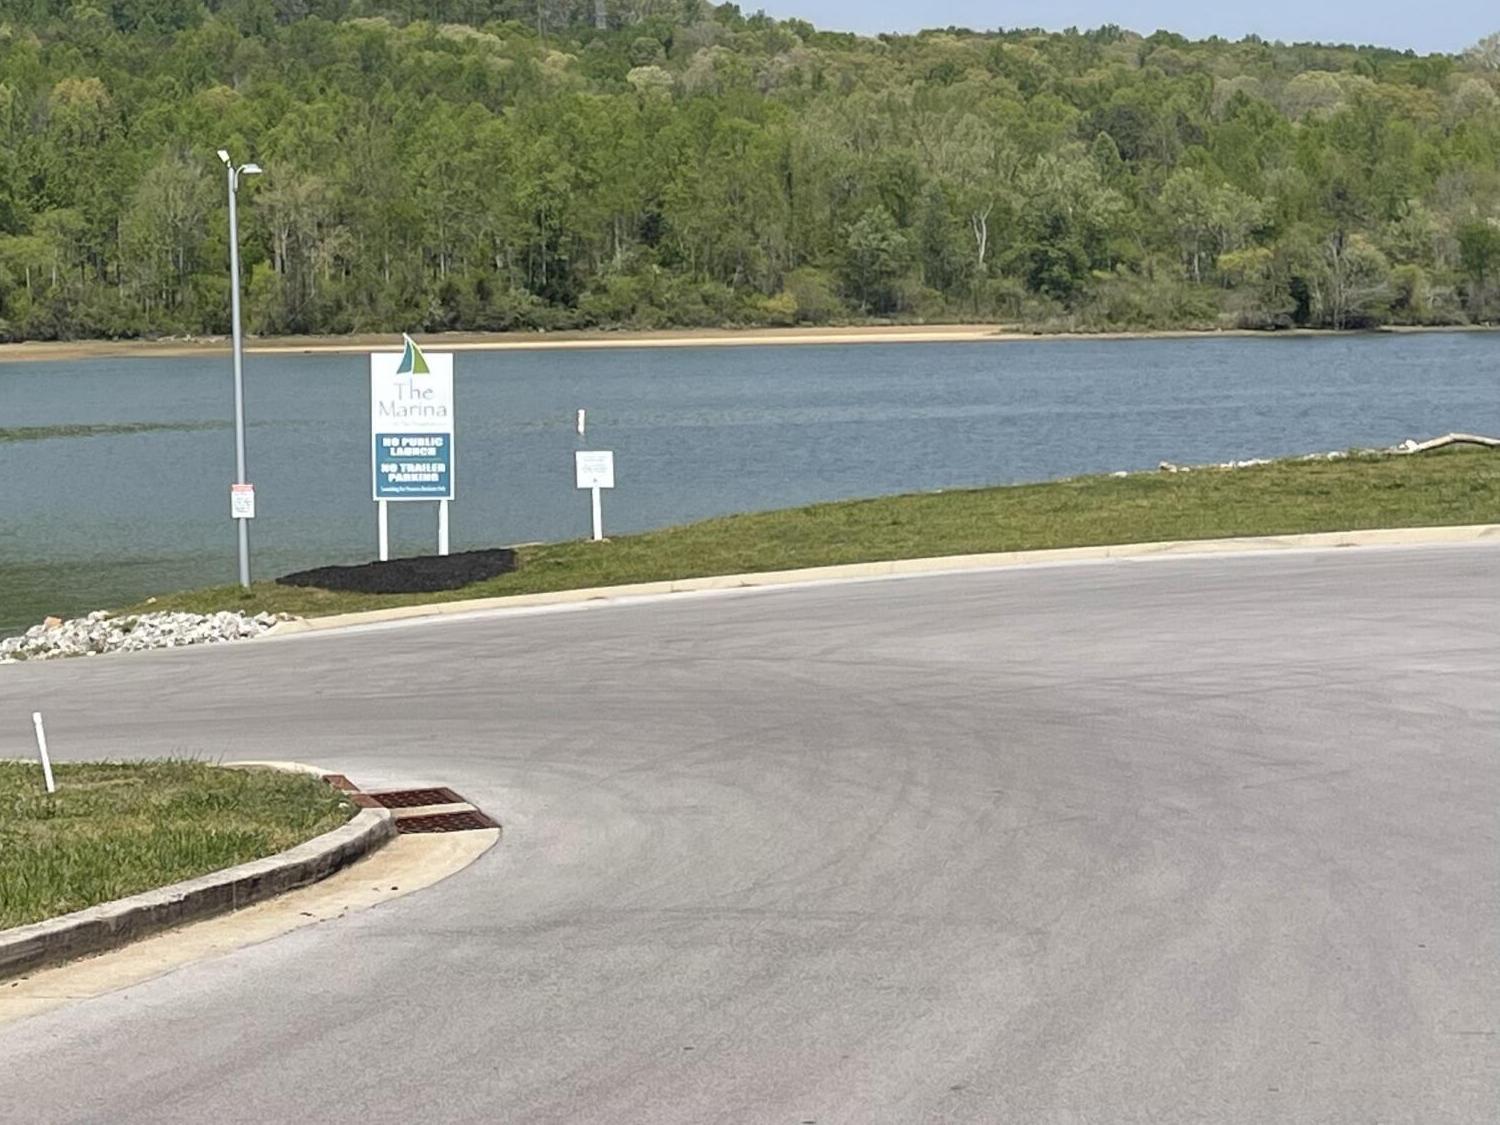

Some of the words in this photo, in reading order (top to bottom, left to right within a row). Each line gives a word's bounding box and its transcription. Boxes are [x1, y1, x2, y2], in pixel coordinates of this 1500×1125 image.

[393, 377, 435, 400] The
[379, 400, 447, 417] Marina
[382, 437, 400, 447] NO
[401, 437, 444, 447] PUBLIC
[381, 463, 398, 473] NO
[399, 463, 446, 473] TRAILER
